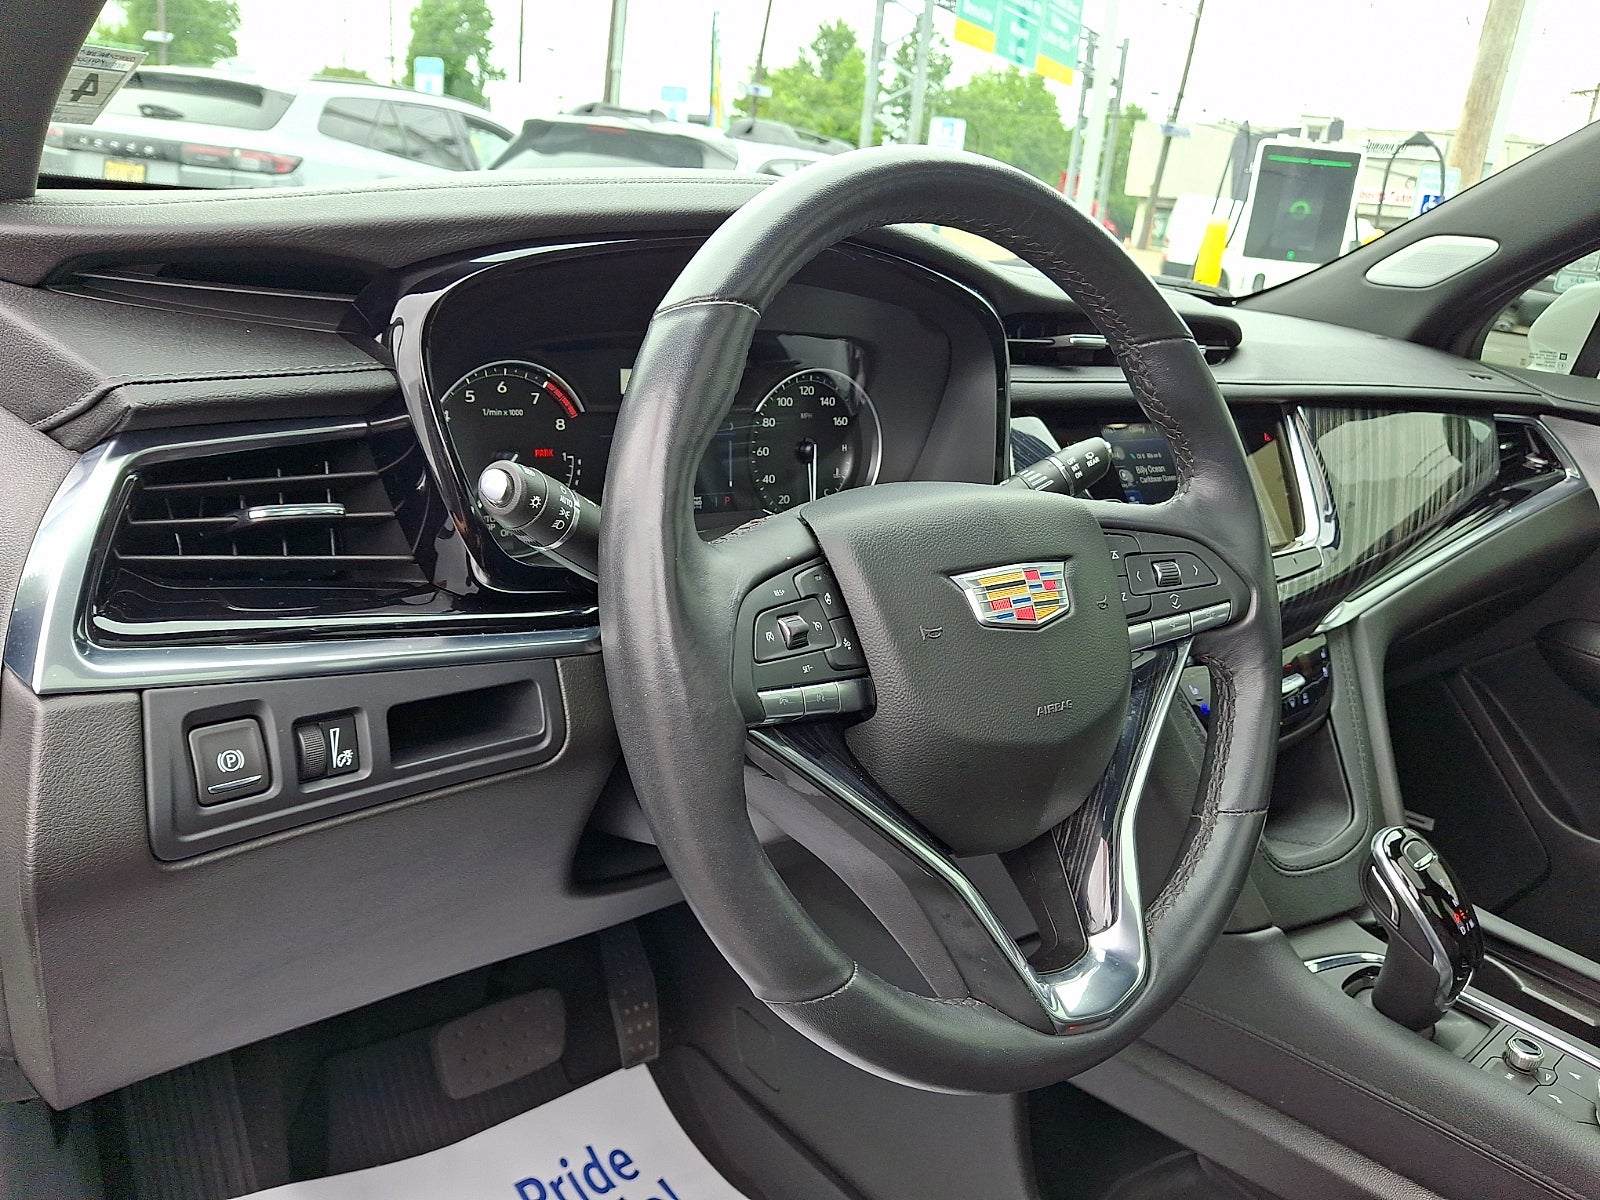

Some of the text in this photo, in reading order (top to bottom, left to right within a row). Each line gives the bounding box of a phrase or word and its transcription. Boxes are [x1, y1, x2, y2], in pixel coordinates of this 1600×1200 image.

[497, 381, 508, 394] 6
[799, 386, 815, 396] 120
[465, 390, 476, 403] 5
[531, 393, 540, 405] 7
[820, 397, 836, 406] 140
[776, 397, 793, 407] 100
[482, 408, 503, 416] 1/min
[555, 418, 566, 431] 8
[762, 418, 776, 428] 80
[833, 417, 848, 426] 160
[756, 447, 770, 457] 60
[842, 444, 848, 452] H
[534, 449, 554, 458] PARK
[1086, 457, 1100, 468] REAR
[1135, 465, 1166, 475] Billy Ocean
[762, 474, 776, 484] 40
[560, 495, 573, 508] AUTO
[724, 496, 731, 505] P
[778, 495, 790, 505] 20
[1036, 699, 1073, 717] AIRBAG
[514, 1145, 640, 1200] Pride
